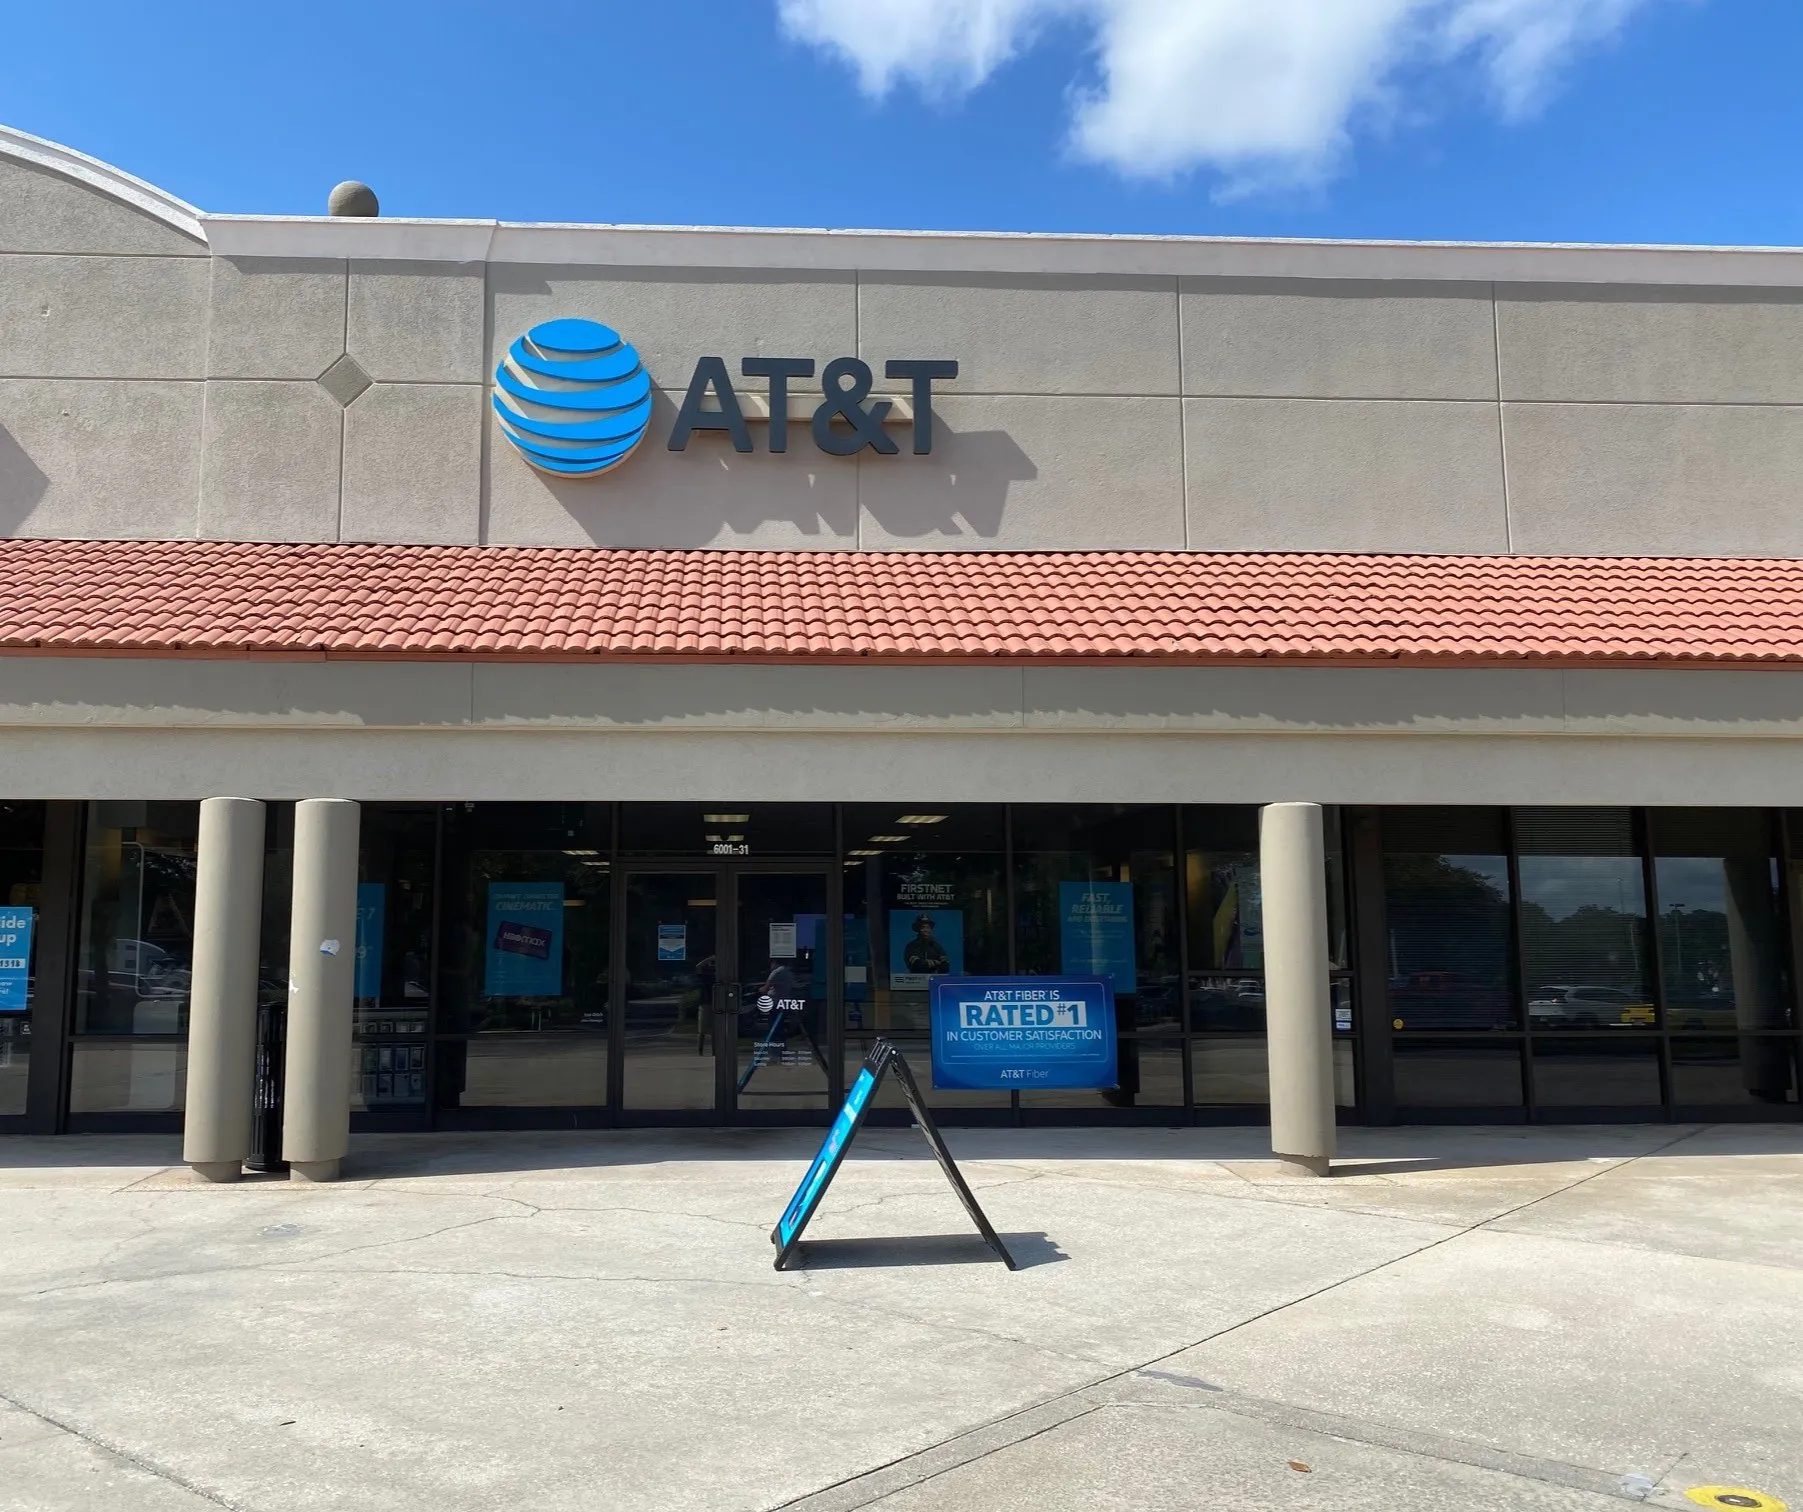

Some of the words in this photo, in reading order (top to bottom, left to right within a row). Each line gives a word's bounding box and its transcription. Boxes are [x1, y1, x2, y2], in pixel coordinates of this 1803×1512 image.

[668, 357, 958, 455] AT&T
[714, 844, 749, 855] 6001-31
[901, 884, 953, 893] FIRSTNET
[984, 990, 1013, 1001] AT&T
[1049, 989, 1060, 1000] IS
[776, 999, 806, 1010] AT&T
[965, 1004, 1055, 1027] RATED
[1056, 1003, 1080, 1025] #1
[947, 1031, 959, 1042] IN
[960, 1030, 1023, 1042] CUSTOMER
[1025, 1029, 1102, 1041] SATISFACTION
[1036, 1042, 1076, 1050] PROVIDERS
[1000, 1069, 1025, 1079] AT&T
[1026, 1069, 1049, 1079] Fiber
